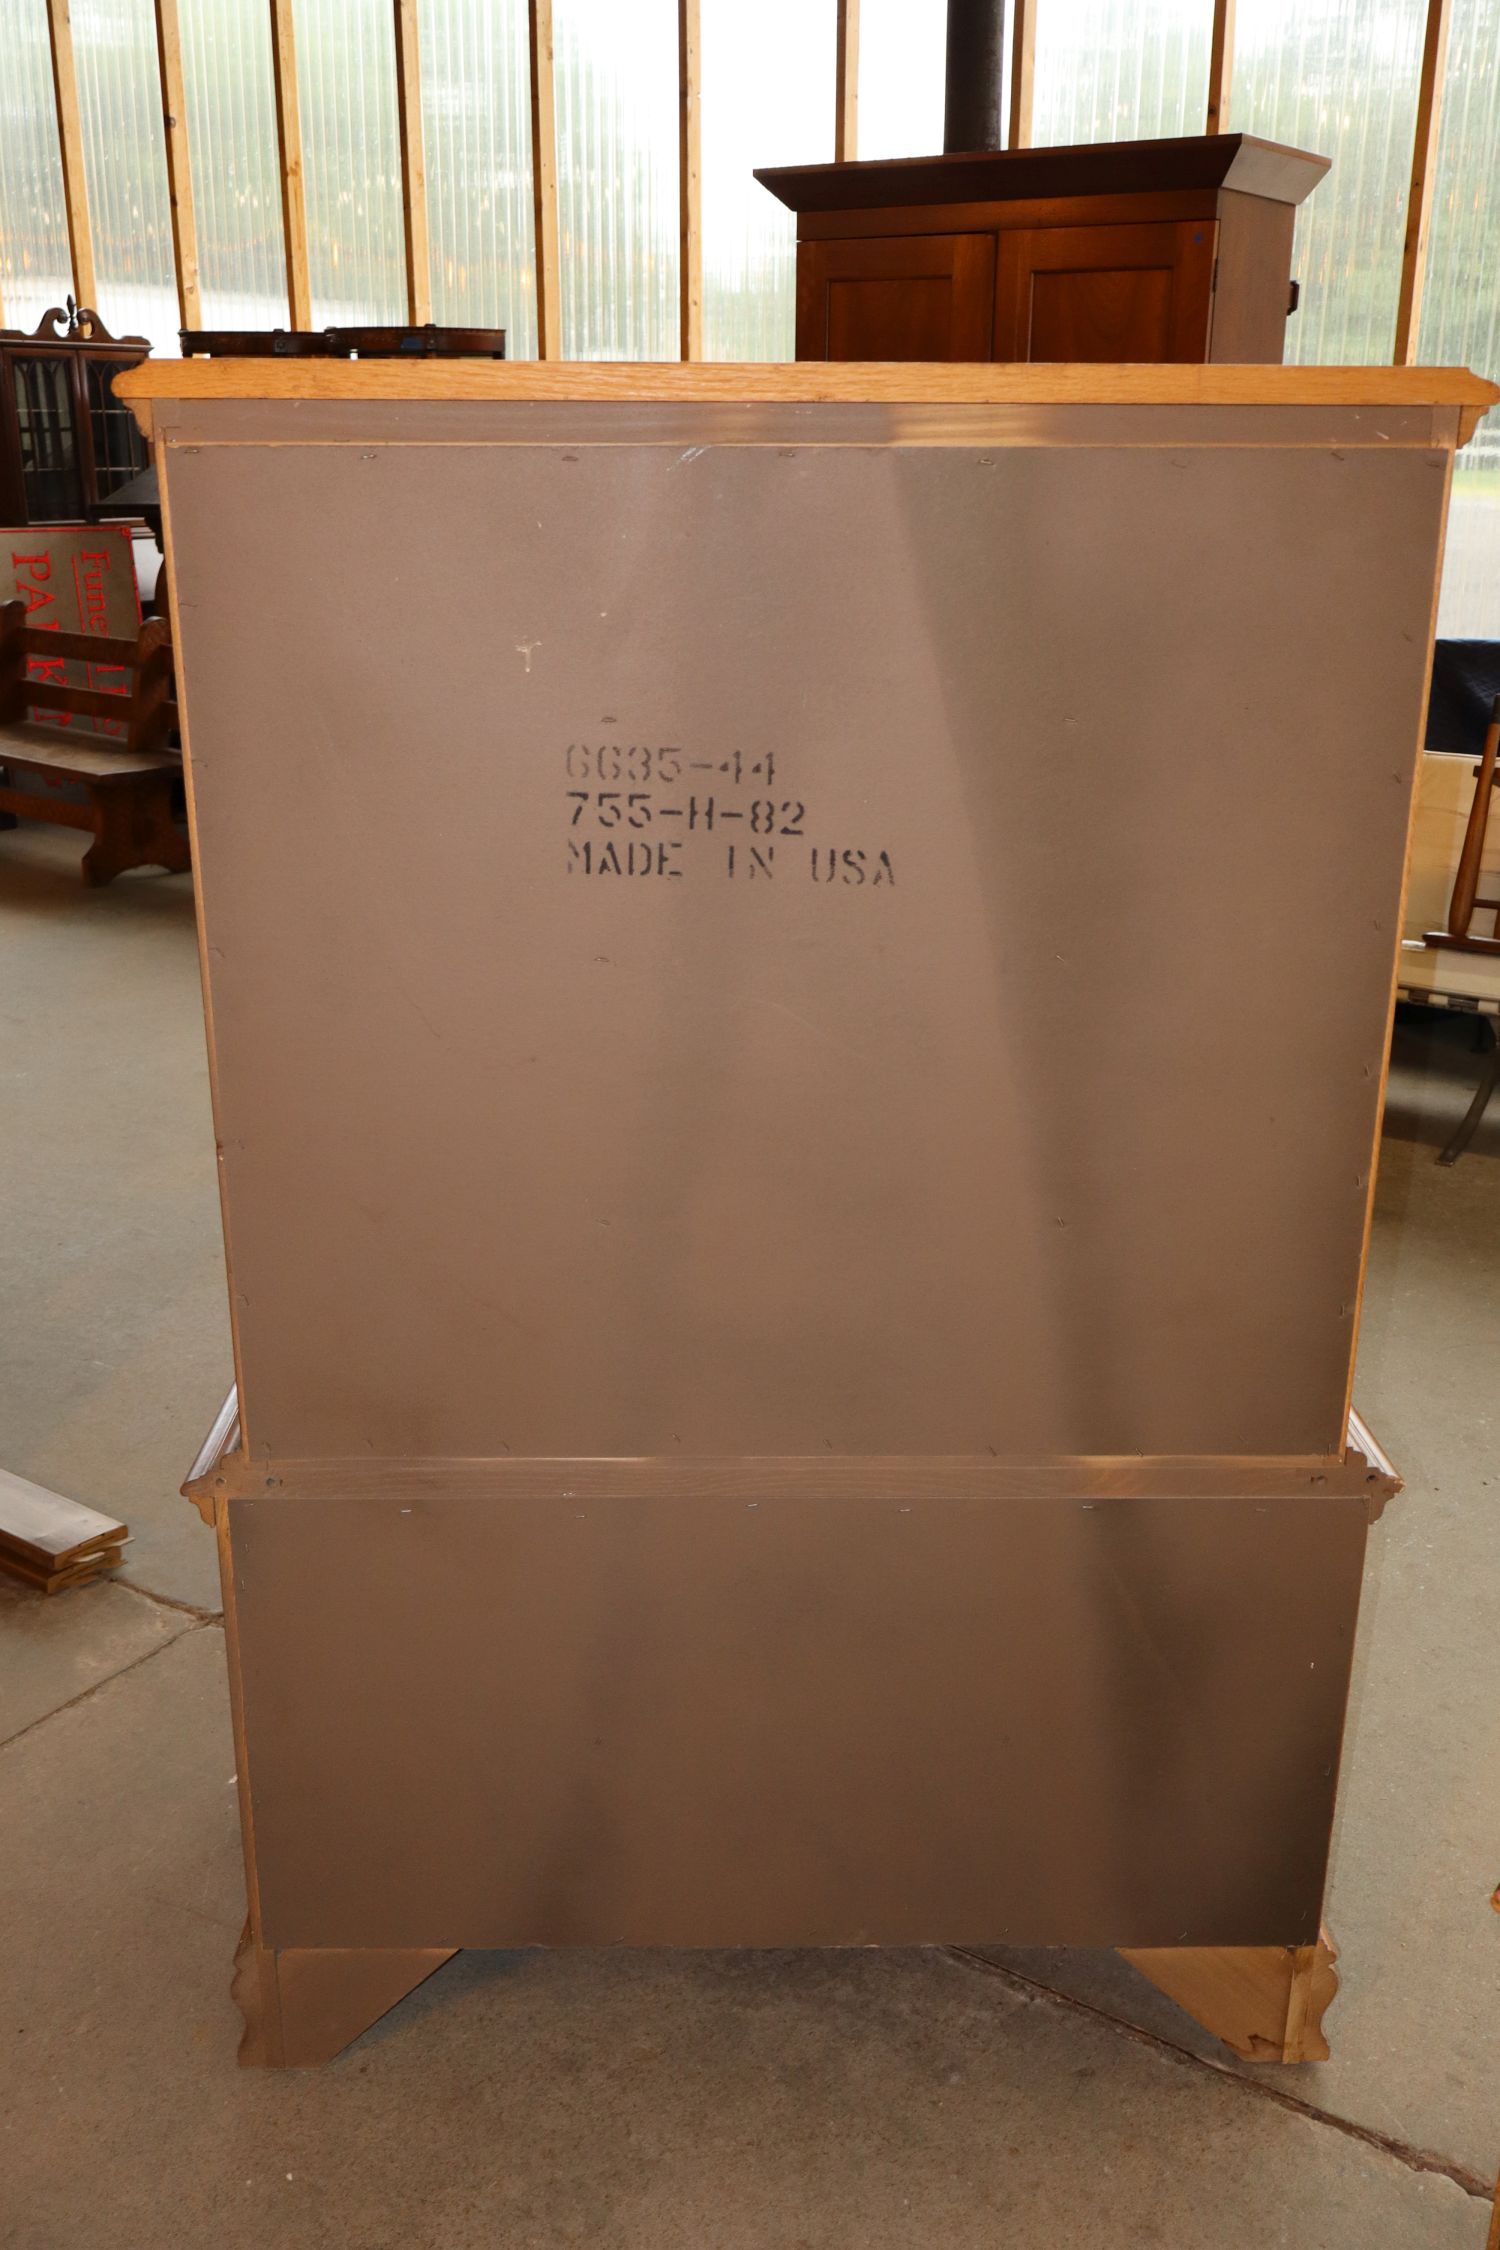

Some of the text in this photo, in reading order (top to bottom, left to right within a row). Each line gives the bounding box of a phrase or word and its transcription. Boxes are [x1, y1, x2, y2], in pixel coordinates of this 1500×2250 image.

[565, 744, 776, 785] 6635-44
[566, 791, 805, 836] 755-H-82
[567, 839, 896, 886] MADE IN USA
